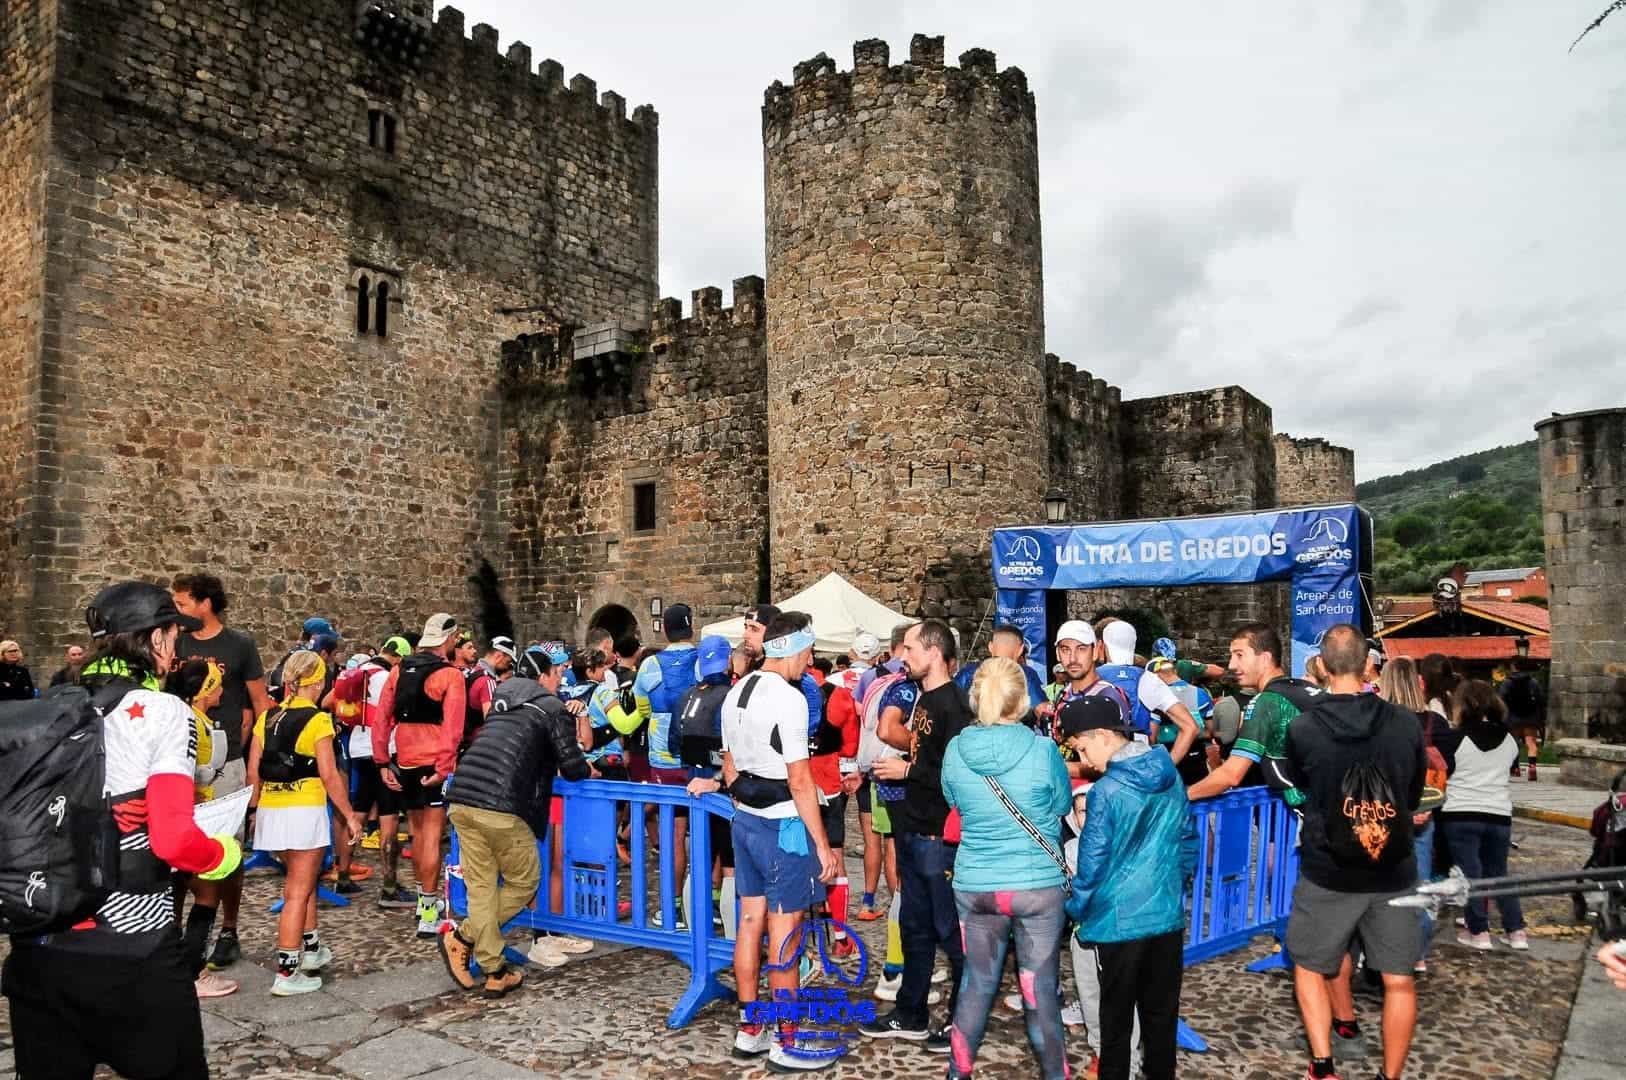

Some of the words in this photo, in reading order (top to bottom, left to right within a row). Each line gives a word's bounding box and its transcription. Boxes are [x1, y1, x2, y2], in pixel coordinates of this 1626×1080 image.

[1056, 544, 1133, 566] ULTRA
[1140, 541, 1173, 562] DE
[1180, 532, 1287, 561] GREDOS
[1296, 548, 1352, 563] GREDOS
[1000, 566, 1044, 576] GREDOS
[1296, 590, 1335, 601] Arenas
[1338, 588, 1353, 600] de
[1296, 604, 1316, 616] San
[1318, 602, 1354, 615] Pedro
